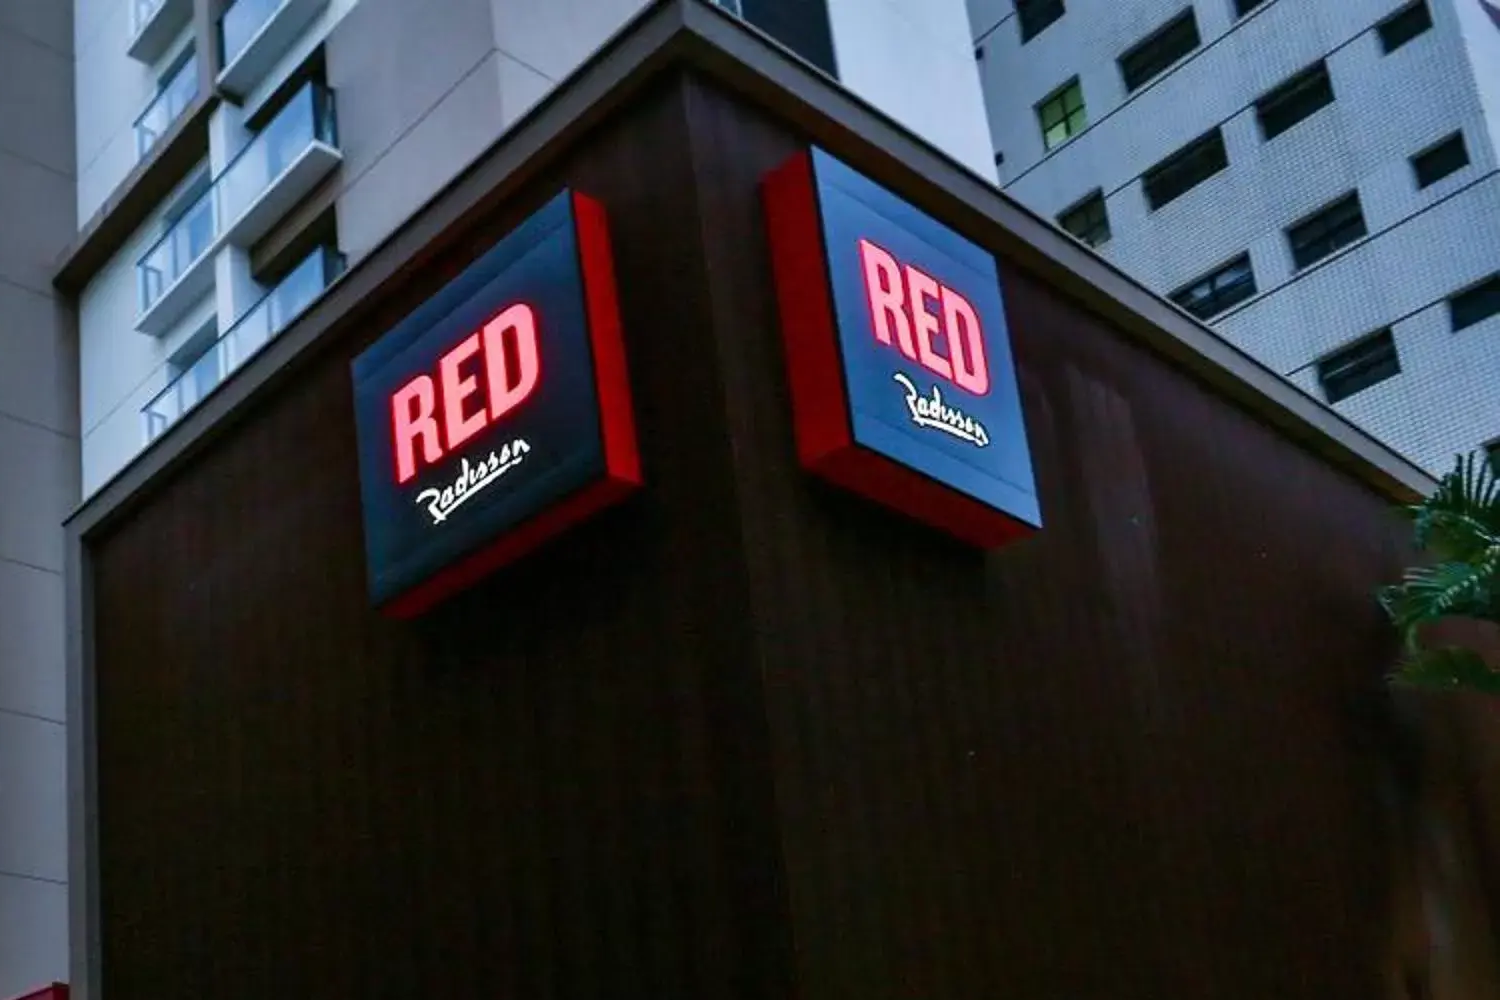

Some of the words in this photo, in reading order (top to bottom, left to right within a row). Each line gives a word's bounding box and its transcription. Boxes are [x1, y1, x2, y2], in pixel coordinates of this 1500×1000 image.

[860, 239, 989, 395] RED
[392, 303, 539, 484] RED
[894, 373, 989, 447] Radisson
[415, 438, 531, 524] Radisson
